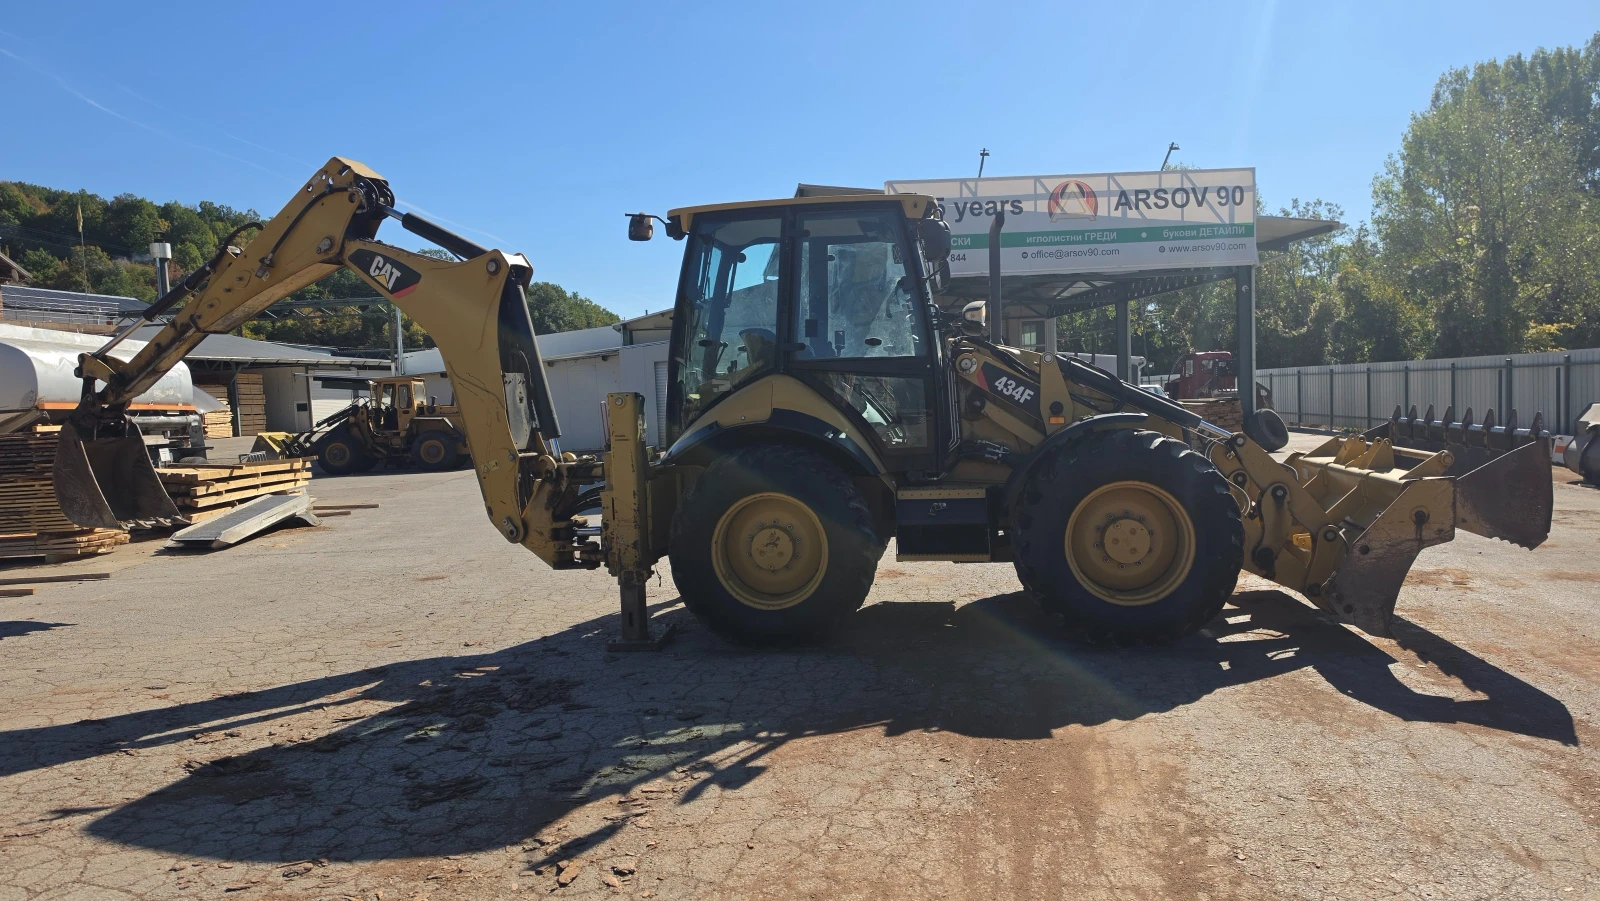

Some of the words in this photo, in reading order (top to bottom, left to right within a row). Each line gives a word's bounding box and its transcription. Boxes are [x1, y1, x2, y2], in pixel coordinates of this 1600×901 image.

[1114, 186, 1208, 211] ARSOV
[1216, 185, 1245, 207] 90
[953, 199, 1024, 223] years
[1026, 234, 1082, 243] иглолистни
[1084, 231, 1117, 242] ГРЕДИ
[1162, 229, 1197, 239] букови
[1199, 225, 1246, 237] ДЕТАЙЛИ
[950, 253, 967, 262] 844
[1030, 247, 1120, 260] office@arsov90.com
[1168, 242, 1247, 253] www.arsov90.com
[370, 255, 402, 290] CAT
[994, 376, 1035, 404] 434F
